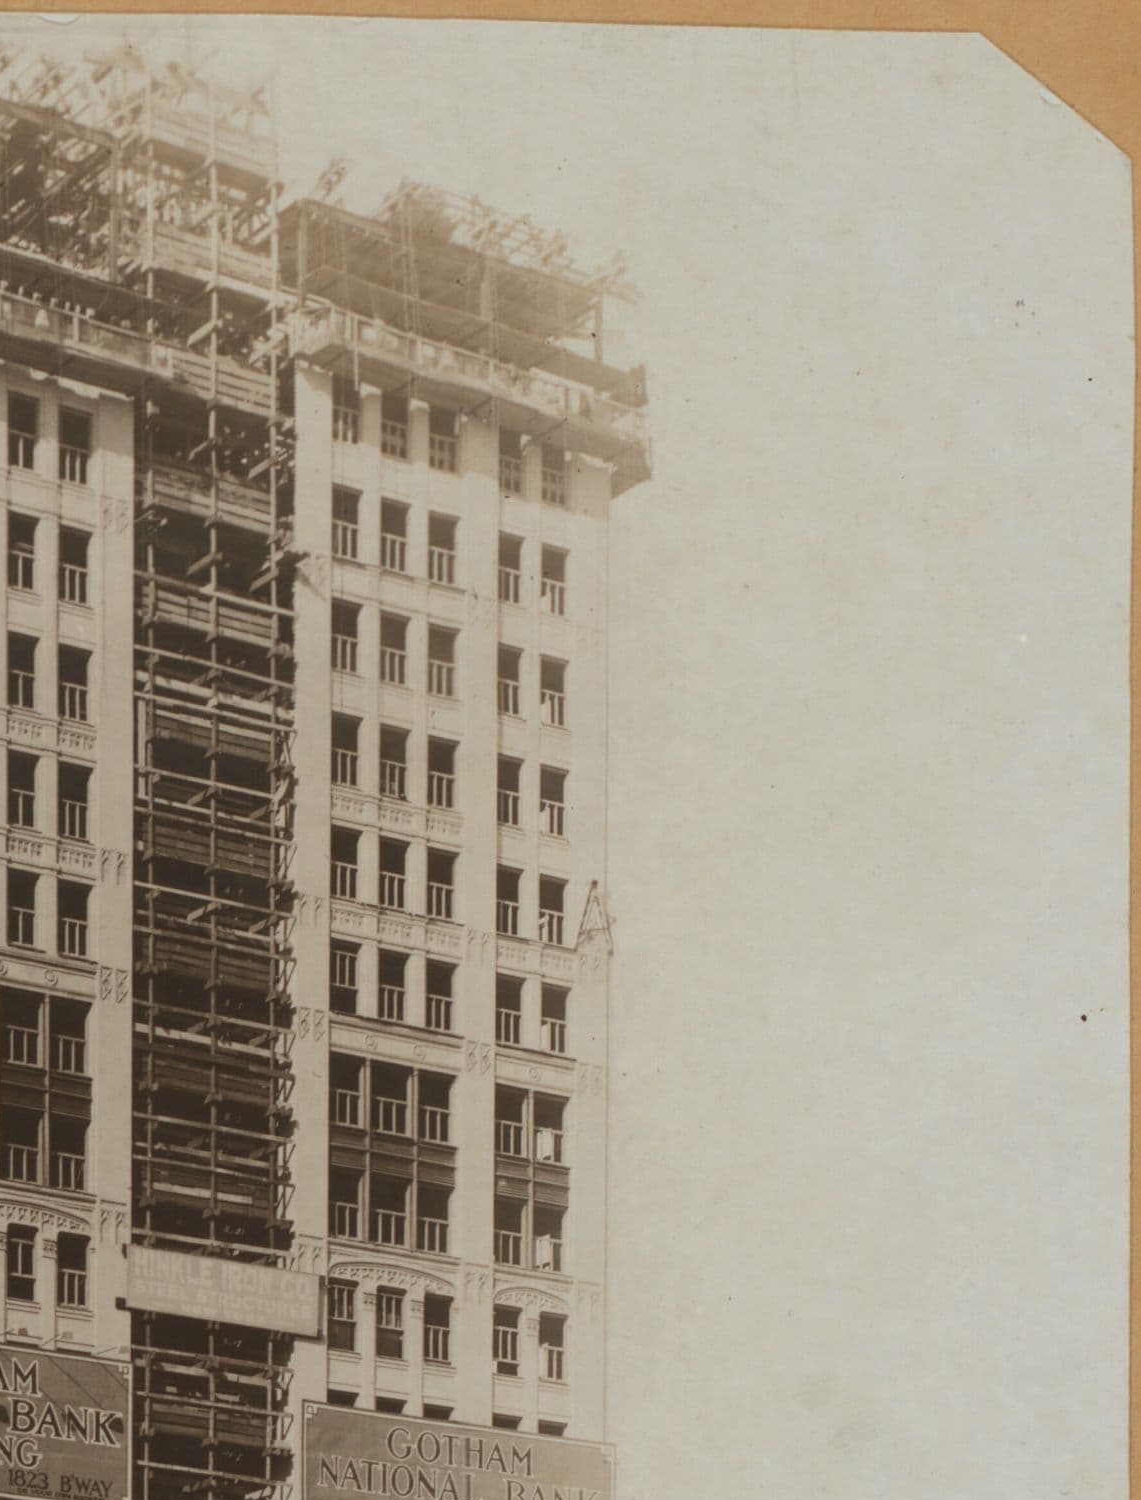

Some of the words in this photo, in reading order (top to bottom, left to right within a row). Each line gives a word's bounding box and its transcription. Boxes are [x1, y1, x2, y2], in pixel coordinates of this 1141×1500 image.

[8, 1398, 123, 1448] BANK
[386, 1426, 533, 1477] GOTHAM
[9, 1468, 49, 1490] 1823
[60, 1473, 113, 1499] B'WAY
